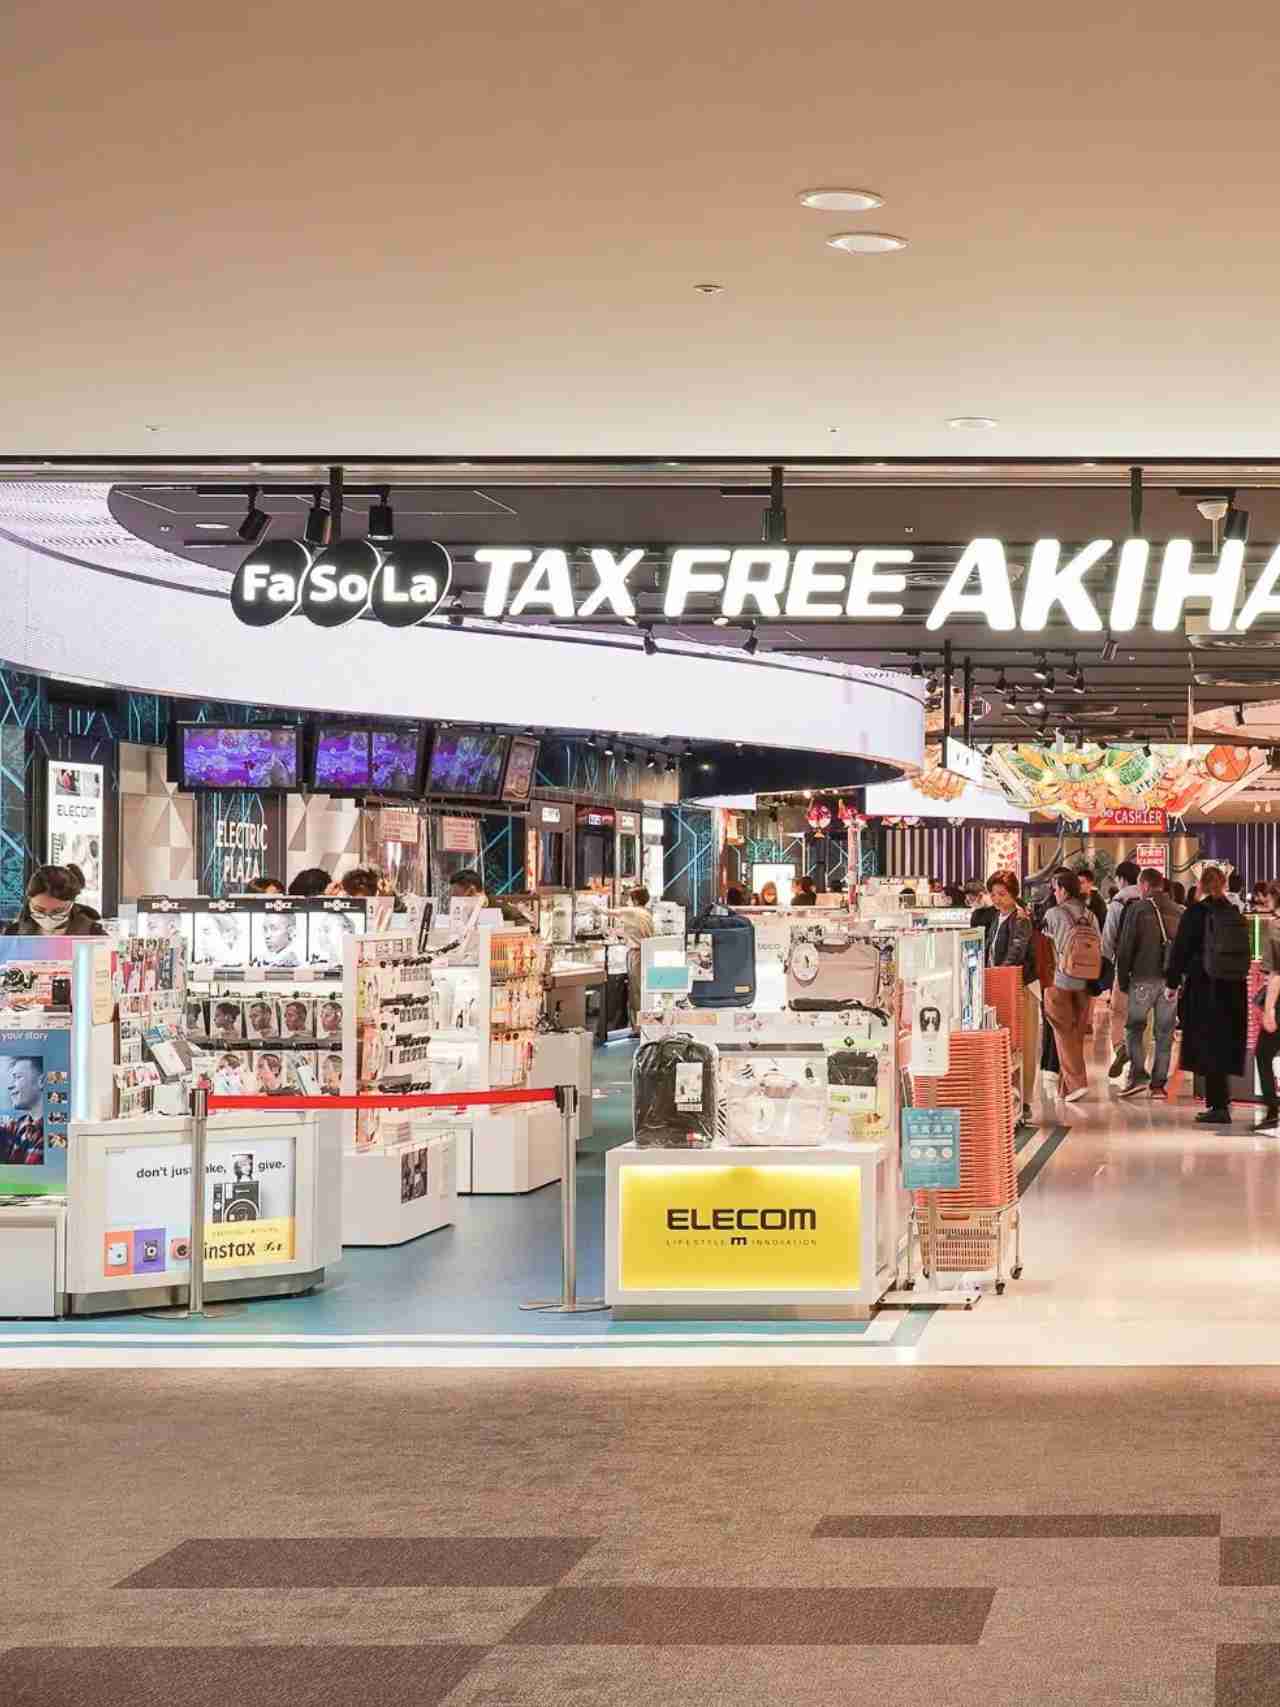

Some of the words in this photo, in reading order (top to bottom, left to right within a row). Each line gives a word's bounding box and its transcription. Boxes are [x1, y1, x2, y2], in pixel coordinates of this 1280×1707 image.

[473, 548, 643, 618] TAX
[663, 548, 914, 618] FREE
[56, 804, 97, 818] ELECOM
[1114, 810, 1163, 825] CASHIER
[217, 819, 268, 850] ELECTRIC
[222, 854, 261, 882] PLAZA
[136, 1166, 168, 1179] don't
[258, 1160, 286, 1172] give.
[666, 1208, 817, 1231] ELECOM
[204, 1241, 256, 1260] instax
[666, 1239, 725, 1247] LIFESTYLE
[751, 1239, 817, 1247] INNOVATION
